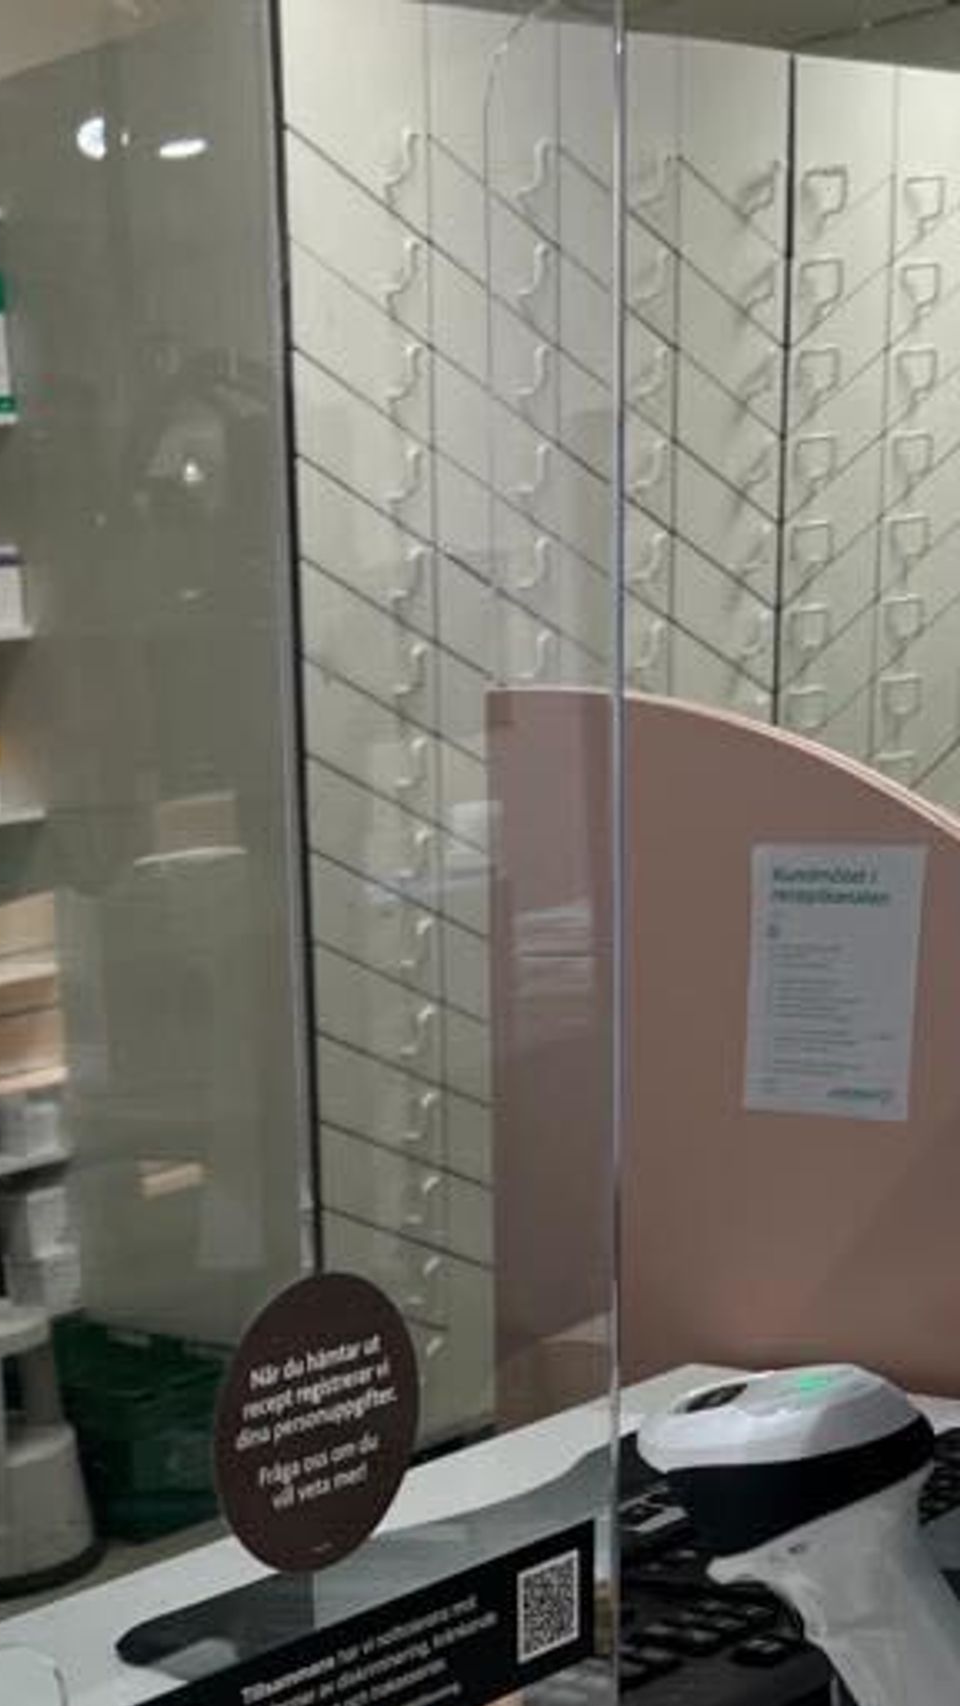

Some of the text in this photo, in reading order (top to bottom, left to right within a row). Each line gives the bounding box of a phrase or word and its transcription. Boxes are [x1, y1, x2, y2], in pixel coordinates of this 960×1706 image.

[242, 1389, 292, 1421] recept
[375, 1356, 391, 1380] vi
[249, 1333, 380, 1391] När du hämtar ut
[235, 1425, 271, 1451] dina
[259, 1459, 300, 1488] Fråga
[330, 1441, 356, 1462] om
[358, 1431, 379, 1455] du
